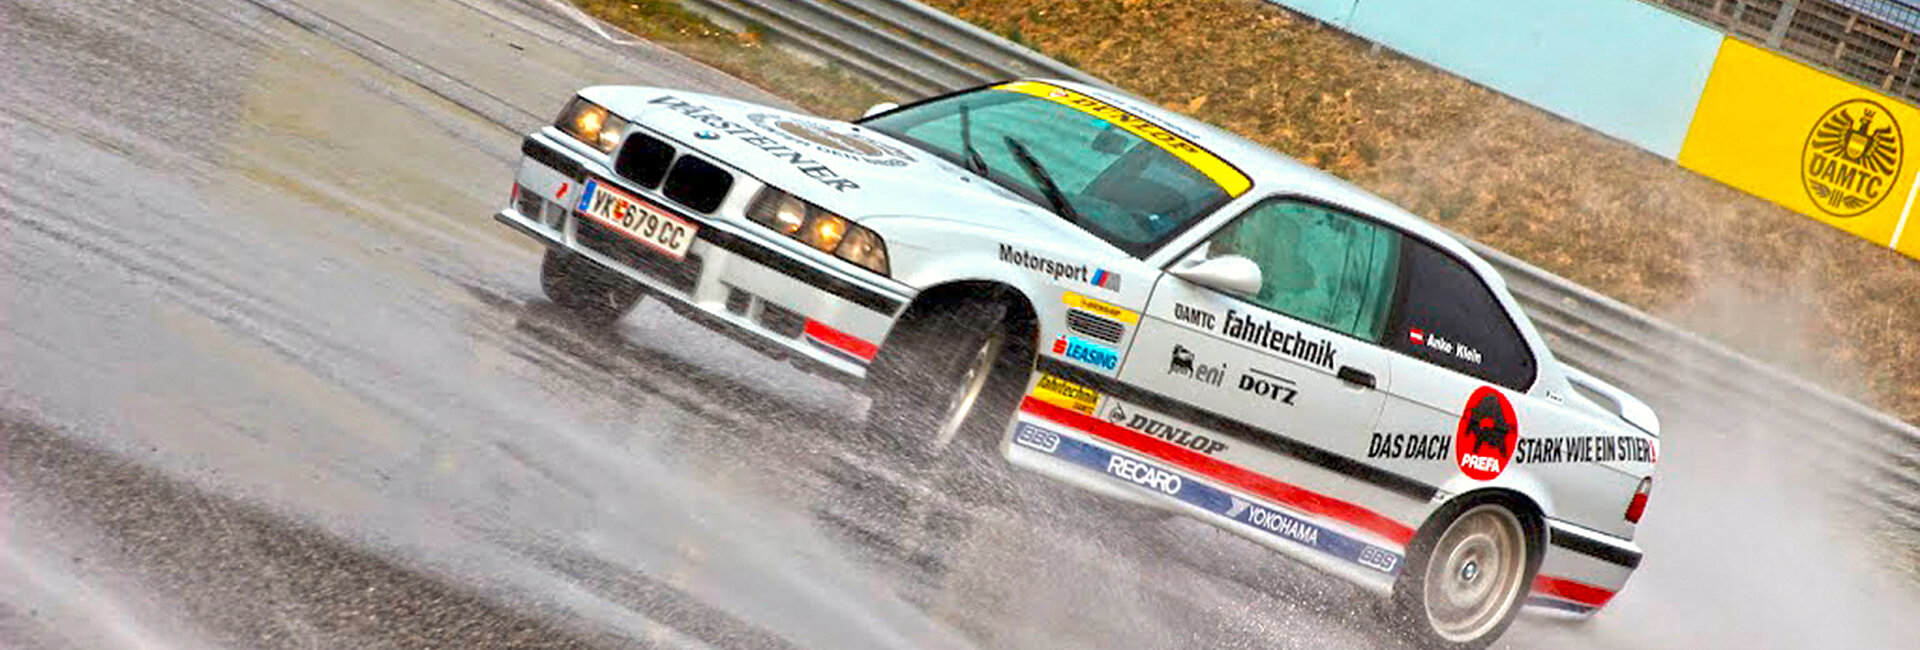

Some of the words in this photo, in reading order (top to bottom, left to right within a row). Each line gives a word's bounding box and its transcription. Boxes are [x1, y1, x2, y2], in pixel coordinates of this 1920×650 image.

[1071, 98, 1199, 153] DUNLOP
[998, 242, 1088, 283] Motorsport
[1066, 342, 1118, 370] LEASING
[1195, 363, 1227, 387] eni
[1238, 374, 1298, 406] DOTZ
[1019, 425, 1059, 451] BBS
[1126, 413, 1225, 455] DUNLOP
[1368, 432, 1404, 458] DAS
[1404, 434, 1452, 460] DACH
[1461, 453, 1501, 473] PREFA
[1516, 437, 1563, 463] STARK
[1565, 436, 1593, 462] WIE
[1594, 436, 1616, 461] EIN
[1107, 455, 1181, 495] RECARO
[1247, 504, 1320, 547] YOKOHAMA
[1360, 546, 1396, 571] BBS
